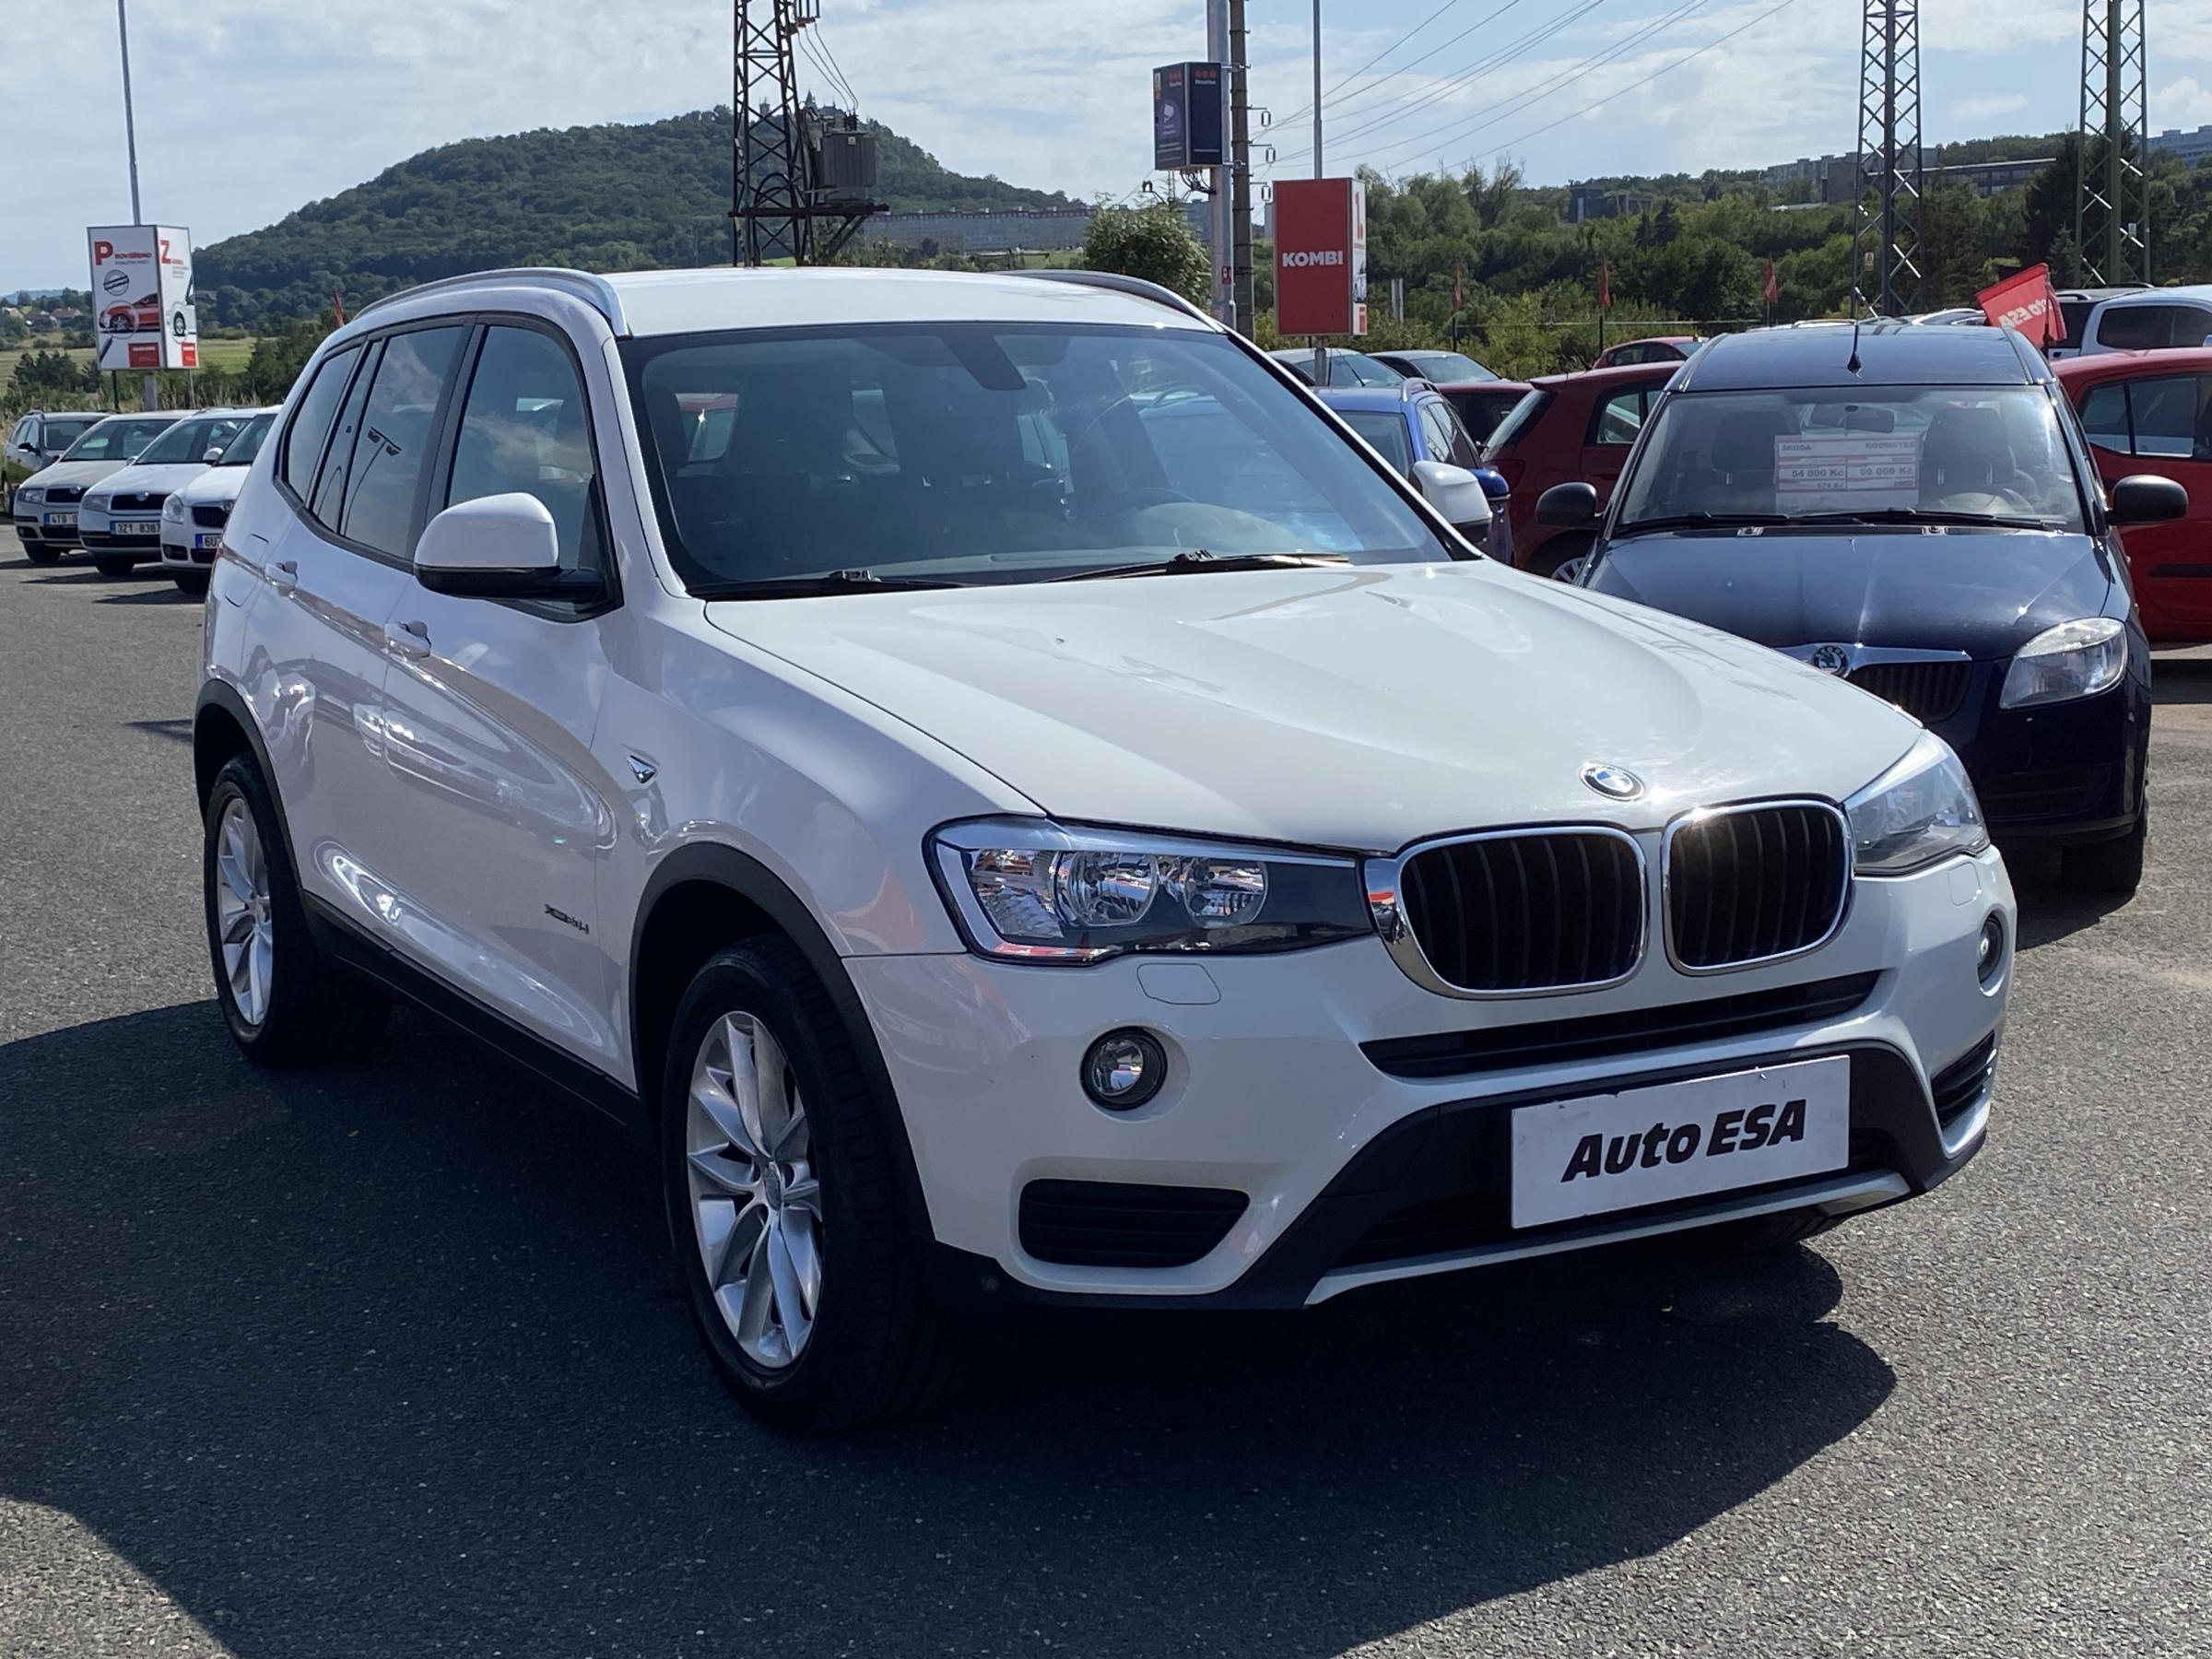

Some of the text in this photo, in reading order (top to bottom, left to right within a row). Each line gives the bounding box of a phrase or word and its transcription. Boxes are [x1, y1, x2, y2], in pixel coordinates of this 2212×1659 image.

[1282, 250, 1344, 267] KOMBI
[1560, 1098, 1806, 1183] Auto ESA
